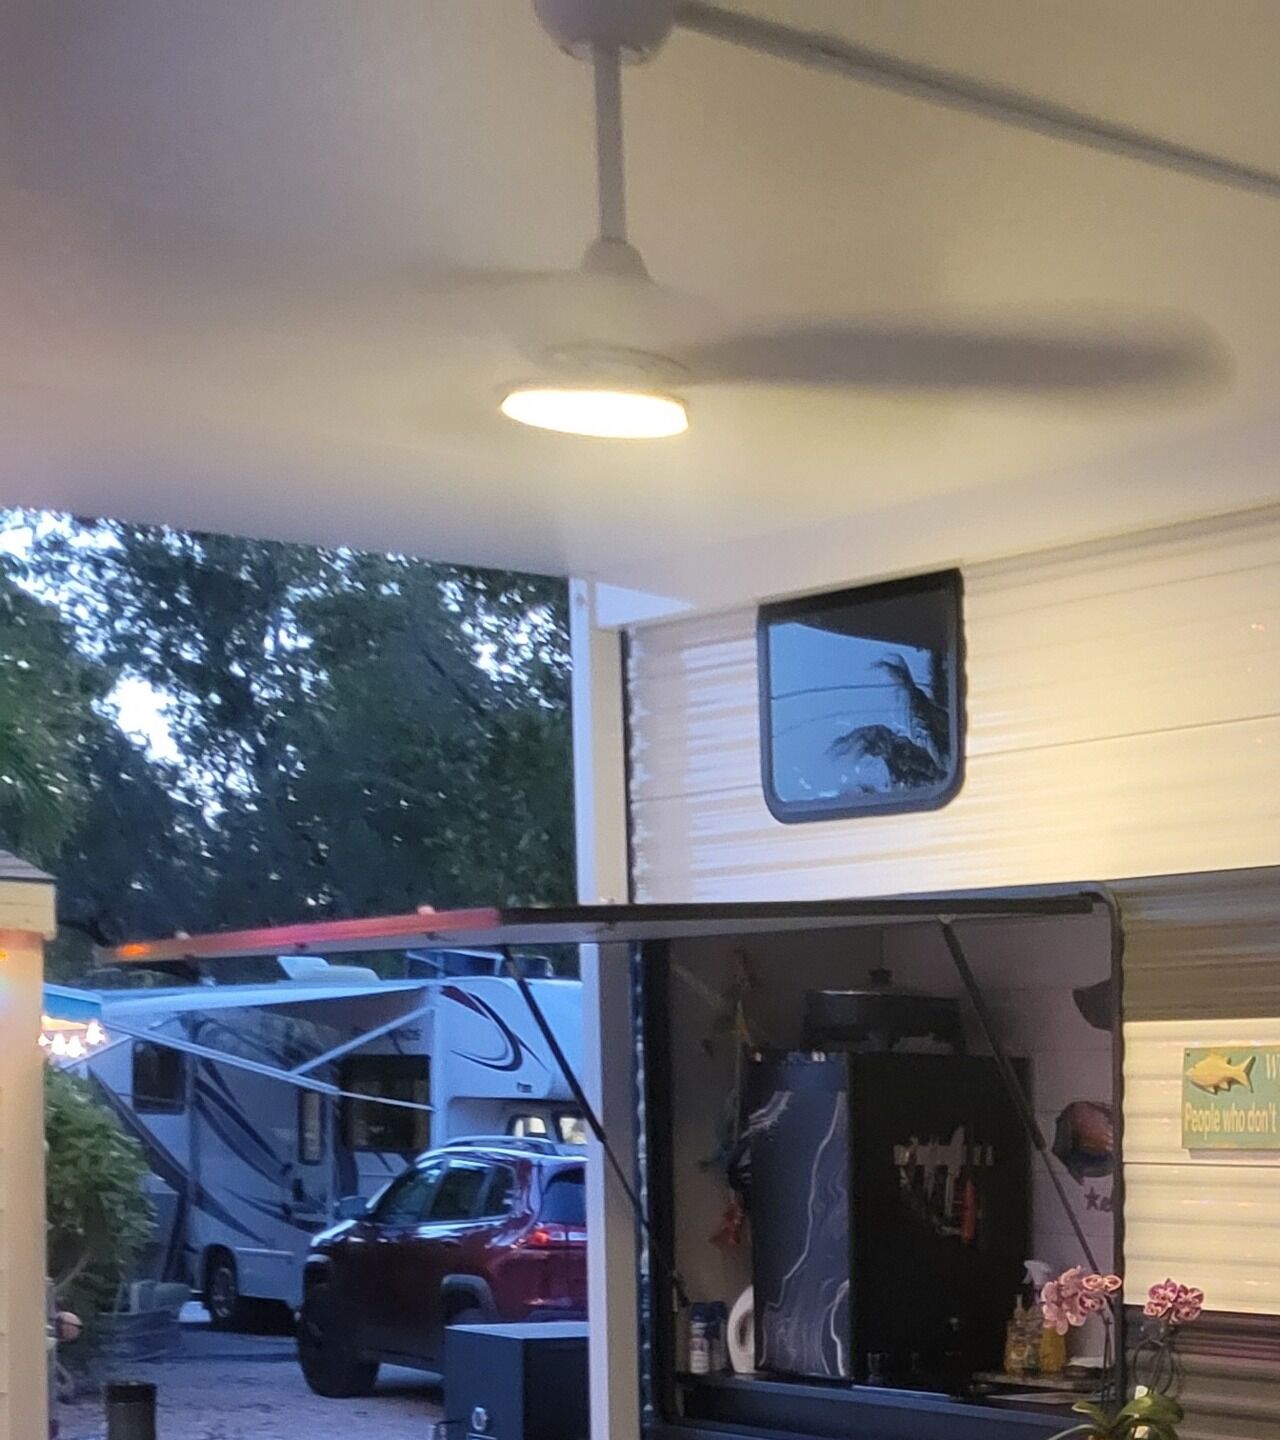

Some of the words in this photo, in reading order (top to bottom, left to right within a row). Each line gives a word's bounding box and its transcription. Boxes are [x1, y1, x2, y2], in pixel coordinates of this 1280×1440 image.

[1184, 1102, 1220, 1140] People
[1222, 1103, 1245, 1133] who
[1247, 1102, 1277, 1133] don't
